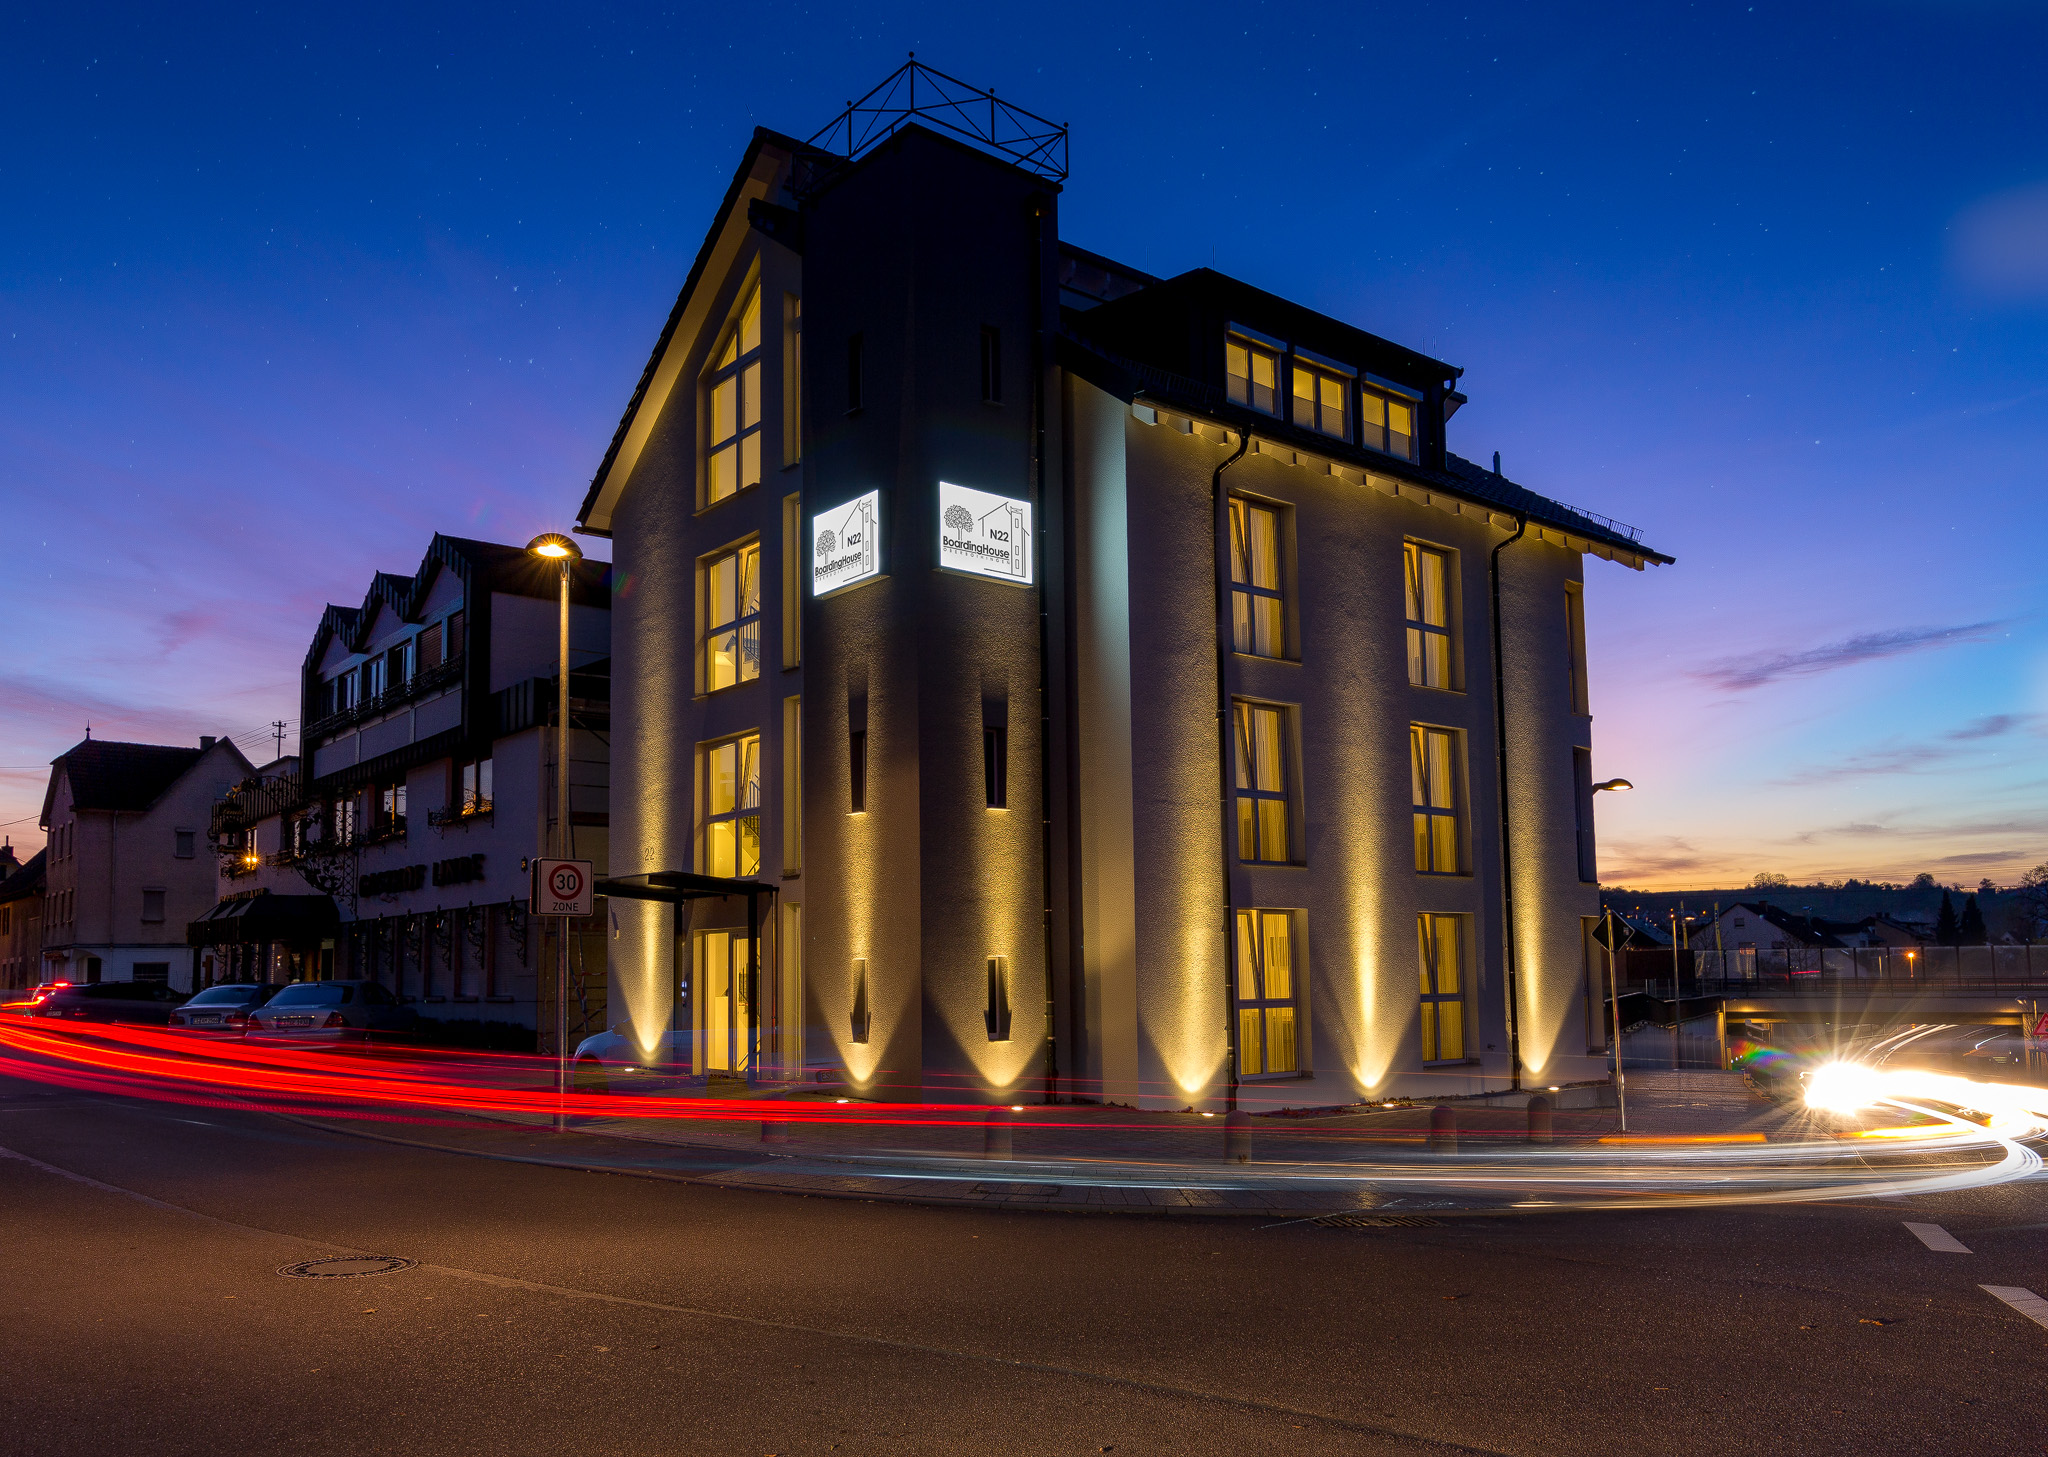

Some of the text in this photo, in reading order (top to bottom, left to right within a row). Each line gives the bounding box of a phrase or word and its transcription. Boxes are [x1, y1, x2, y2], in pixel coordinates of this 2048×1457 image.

[848, 532, 861, 547] N22
[990, 528, 1009, 542] N22
[943, 535, 1010, 559] BoardingHouse
[815, 552, 861, 576] BoardingHouse
[644, 848, 655, 861] 22
[556, 874, 576, 890] 30
[553, 902, 578, 911] ZONE
